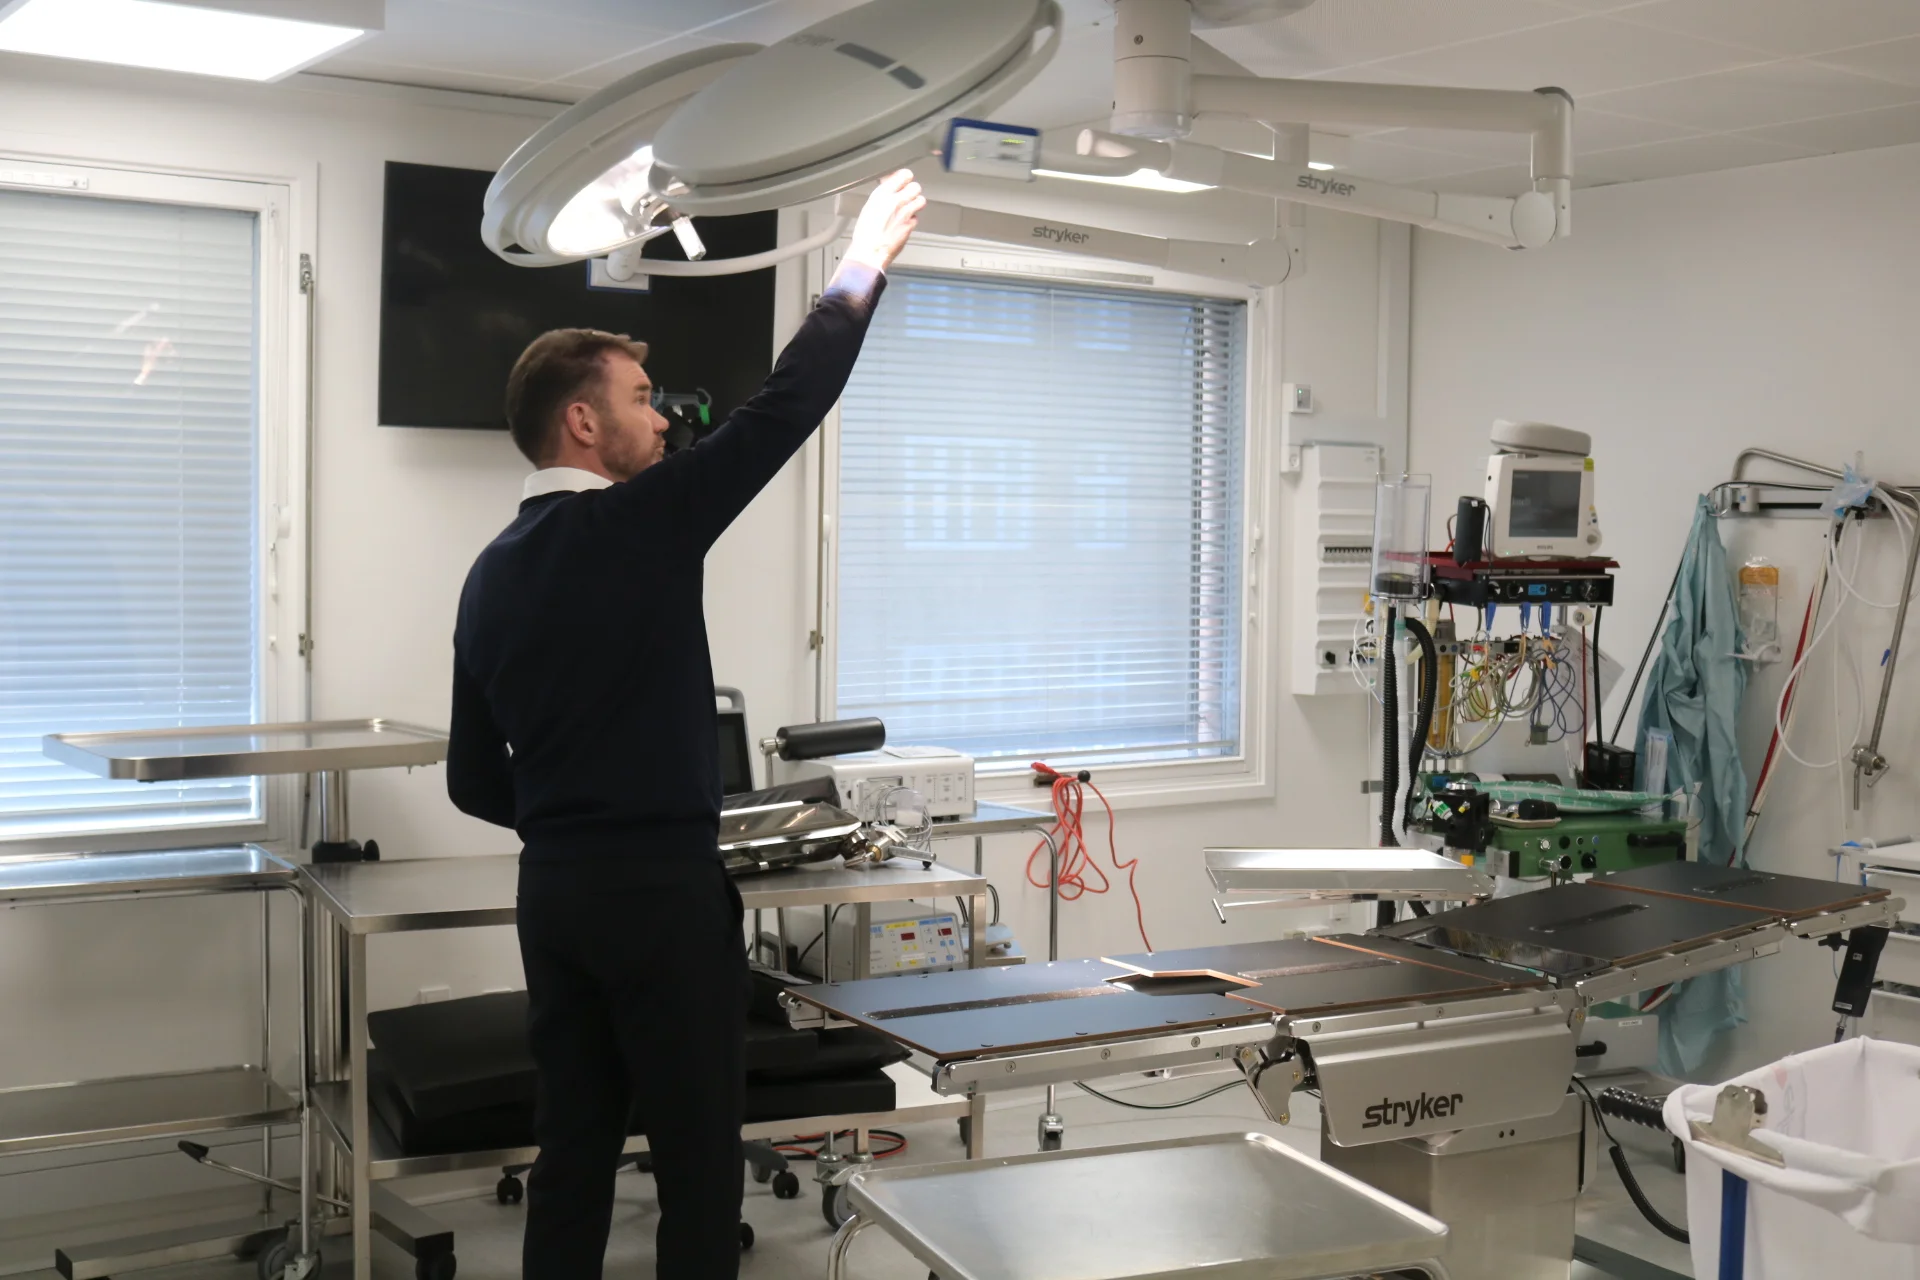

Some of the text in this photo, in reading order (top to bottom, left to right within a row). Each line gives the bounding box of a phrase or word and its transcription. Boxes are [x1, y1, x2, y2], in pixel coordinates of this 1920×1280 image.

[1296, 174, 1356, 197] stryker
[1032, 226, 1090, 244] stryker
[1362, 1092, 1463, 1128] stryker
